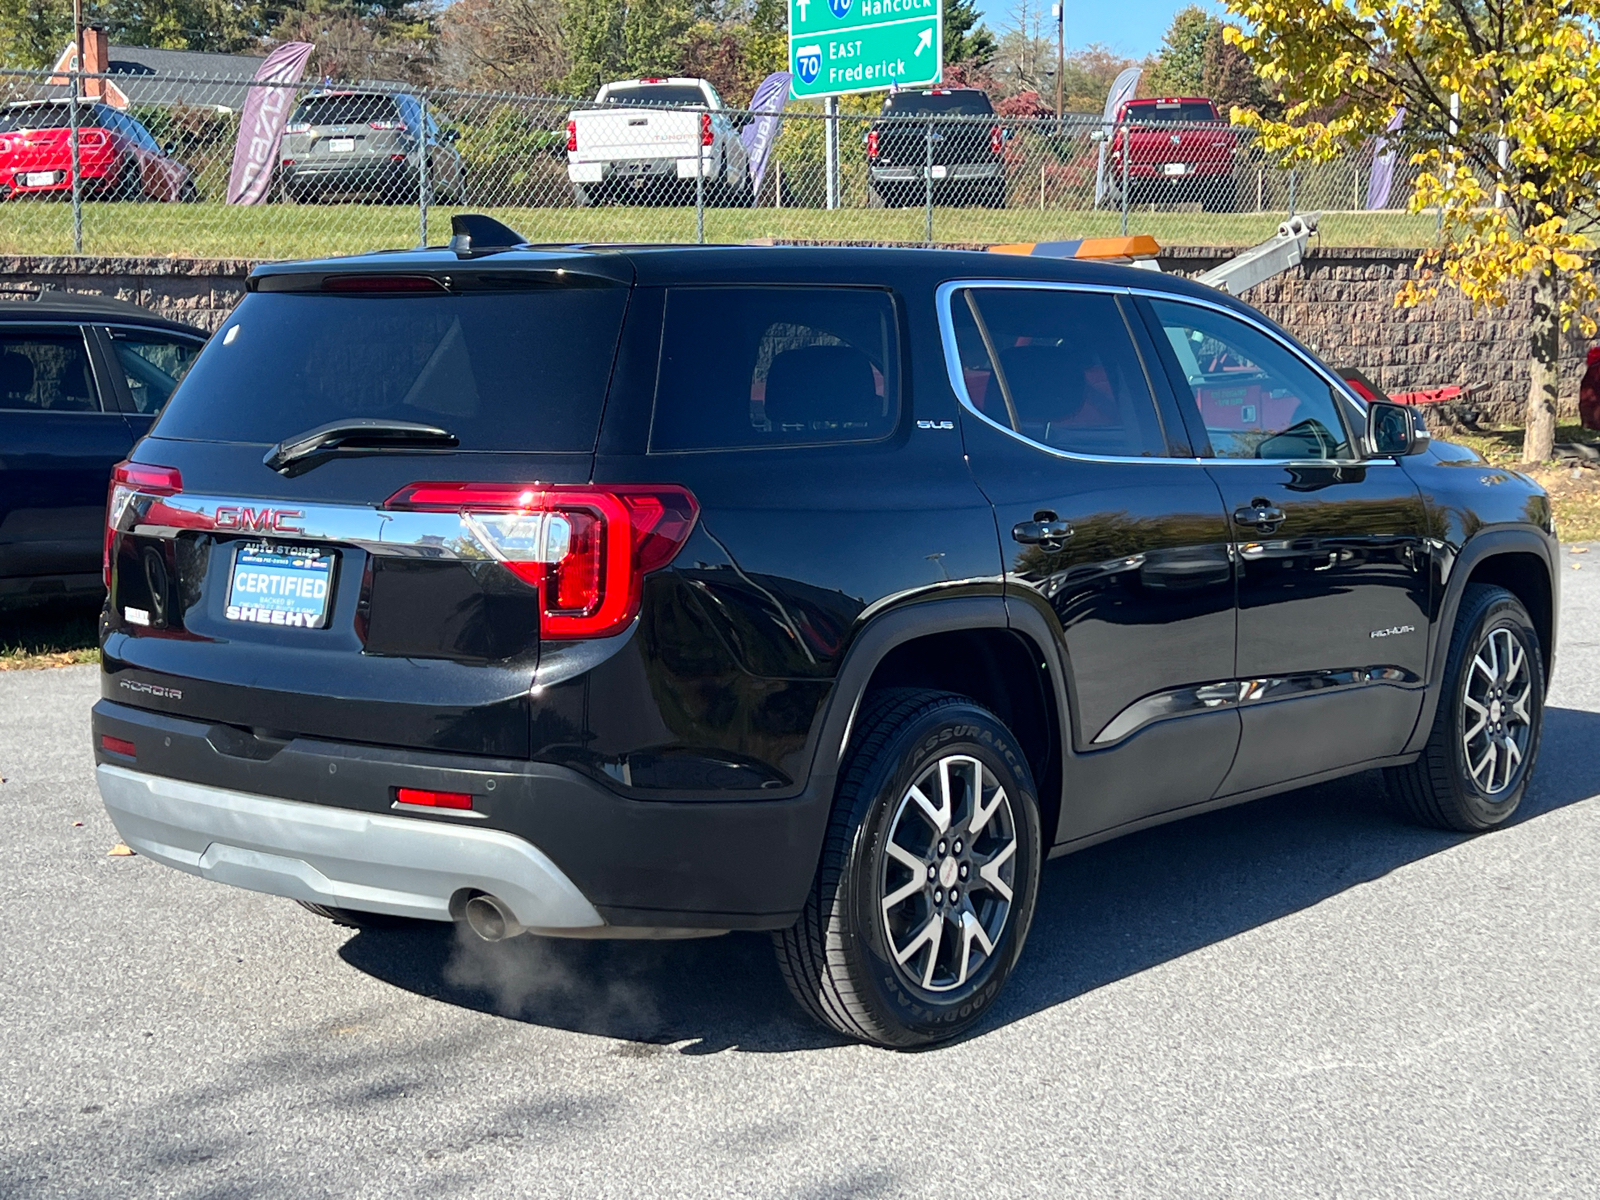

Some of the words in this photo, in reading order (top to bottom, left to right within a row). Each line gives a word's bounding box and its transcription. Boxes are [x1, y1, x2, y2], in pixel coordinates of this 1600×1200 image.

[861, 0, 932, 17] Hancock
[829, 41, 862, 60] EAST
[799, 57, 819, 77] 70
[829, 58, 906, 83] Frederick
[214, 505, 306, 534] GMC
[236, 572, 327, 598] CERTIFIED
[225, 605, 320, 628] SHEEHY
[911, 724, 1026, 781] ASSURANCE
[884, 973, 998, 1025] GOODYEAR
